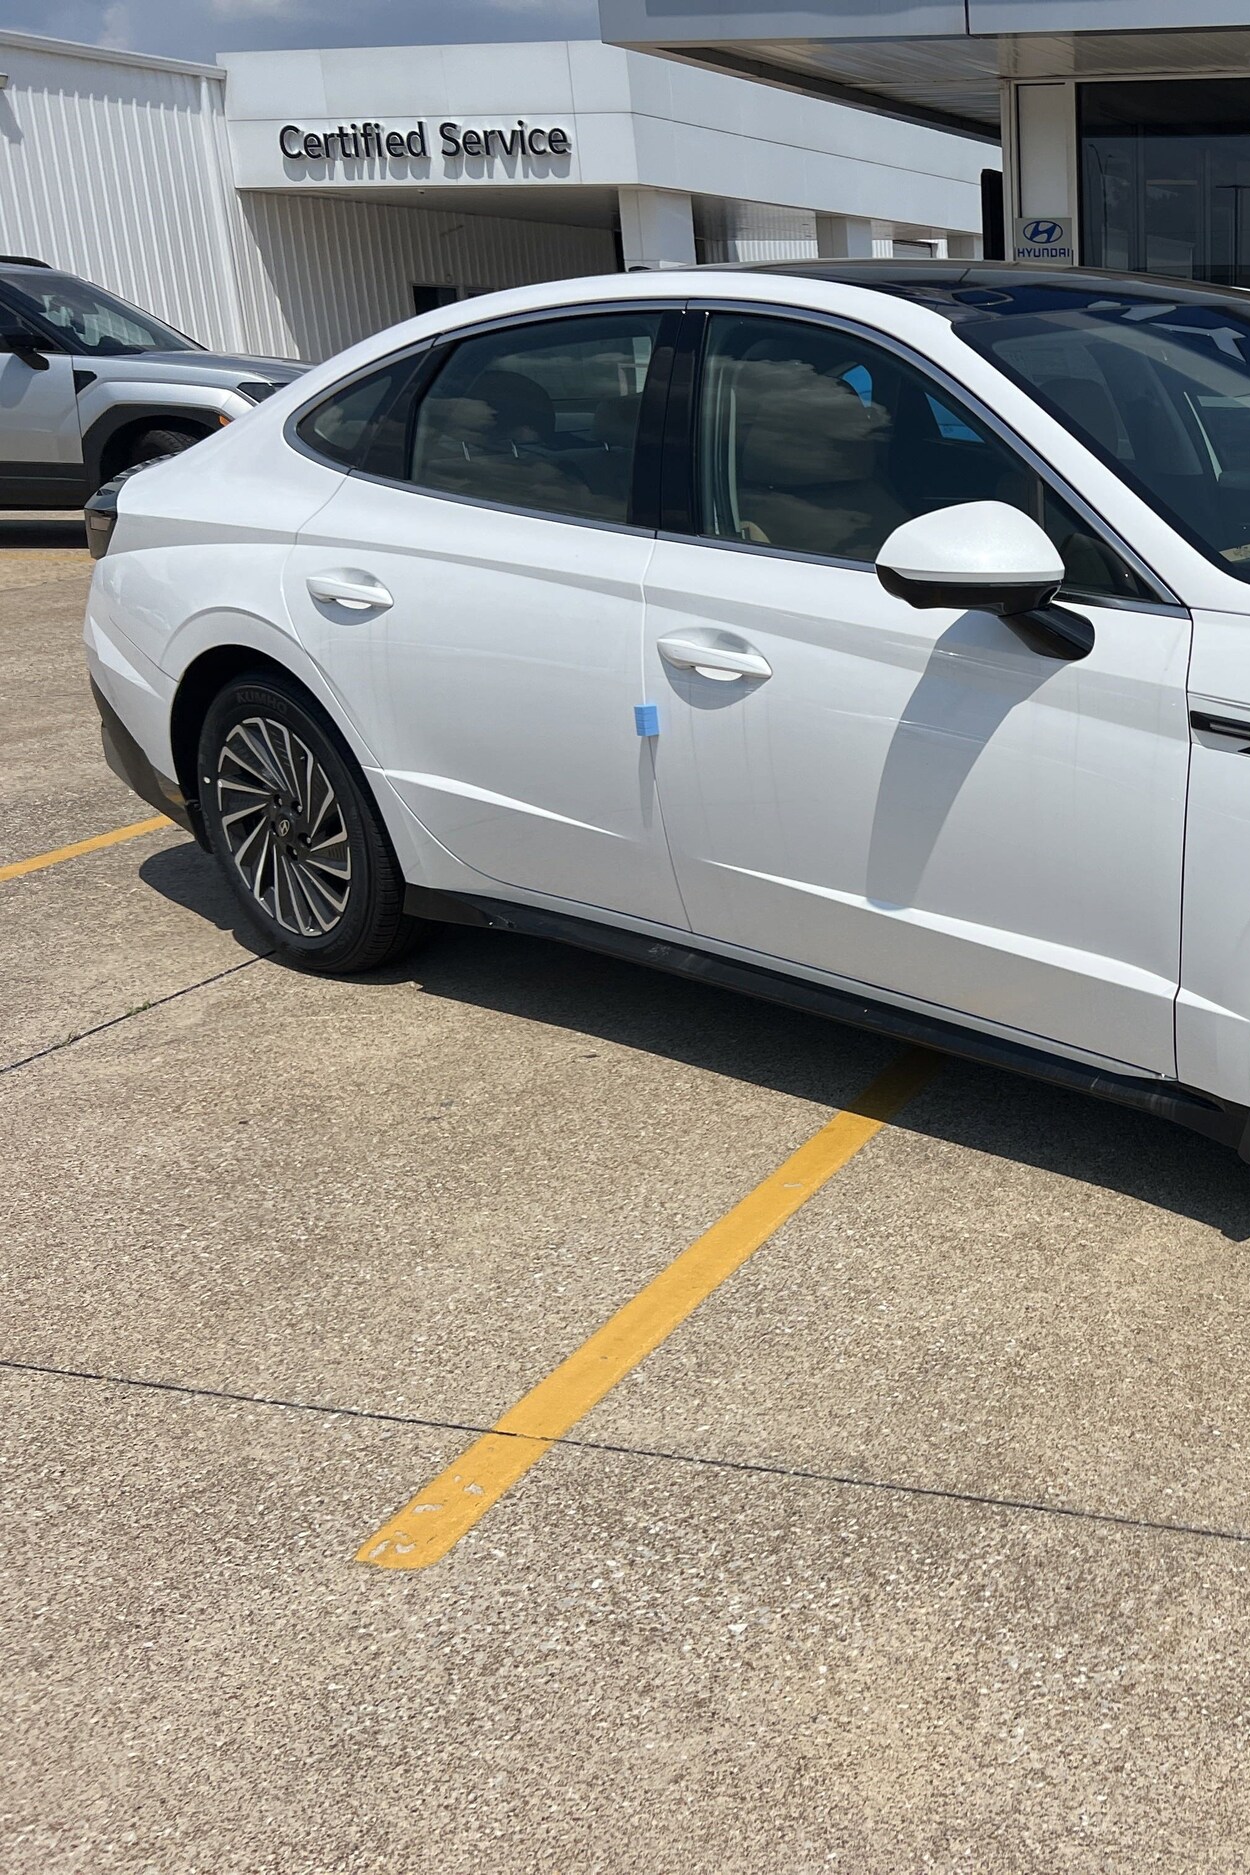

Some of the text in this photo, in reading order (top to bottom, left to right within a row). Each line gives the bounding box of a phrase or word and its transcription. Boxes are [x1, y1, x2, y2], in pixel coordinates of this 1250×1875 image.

[278, 119, 572, 160] Certified Service
[1017, 247, 1070, 258] HYUNDAI
[236, 690, 288, 715] KUMHO
